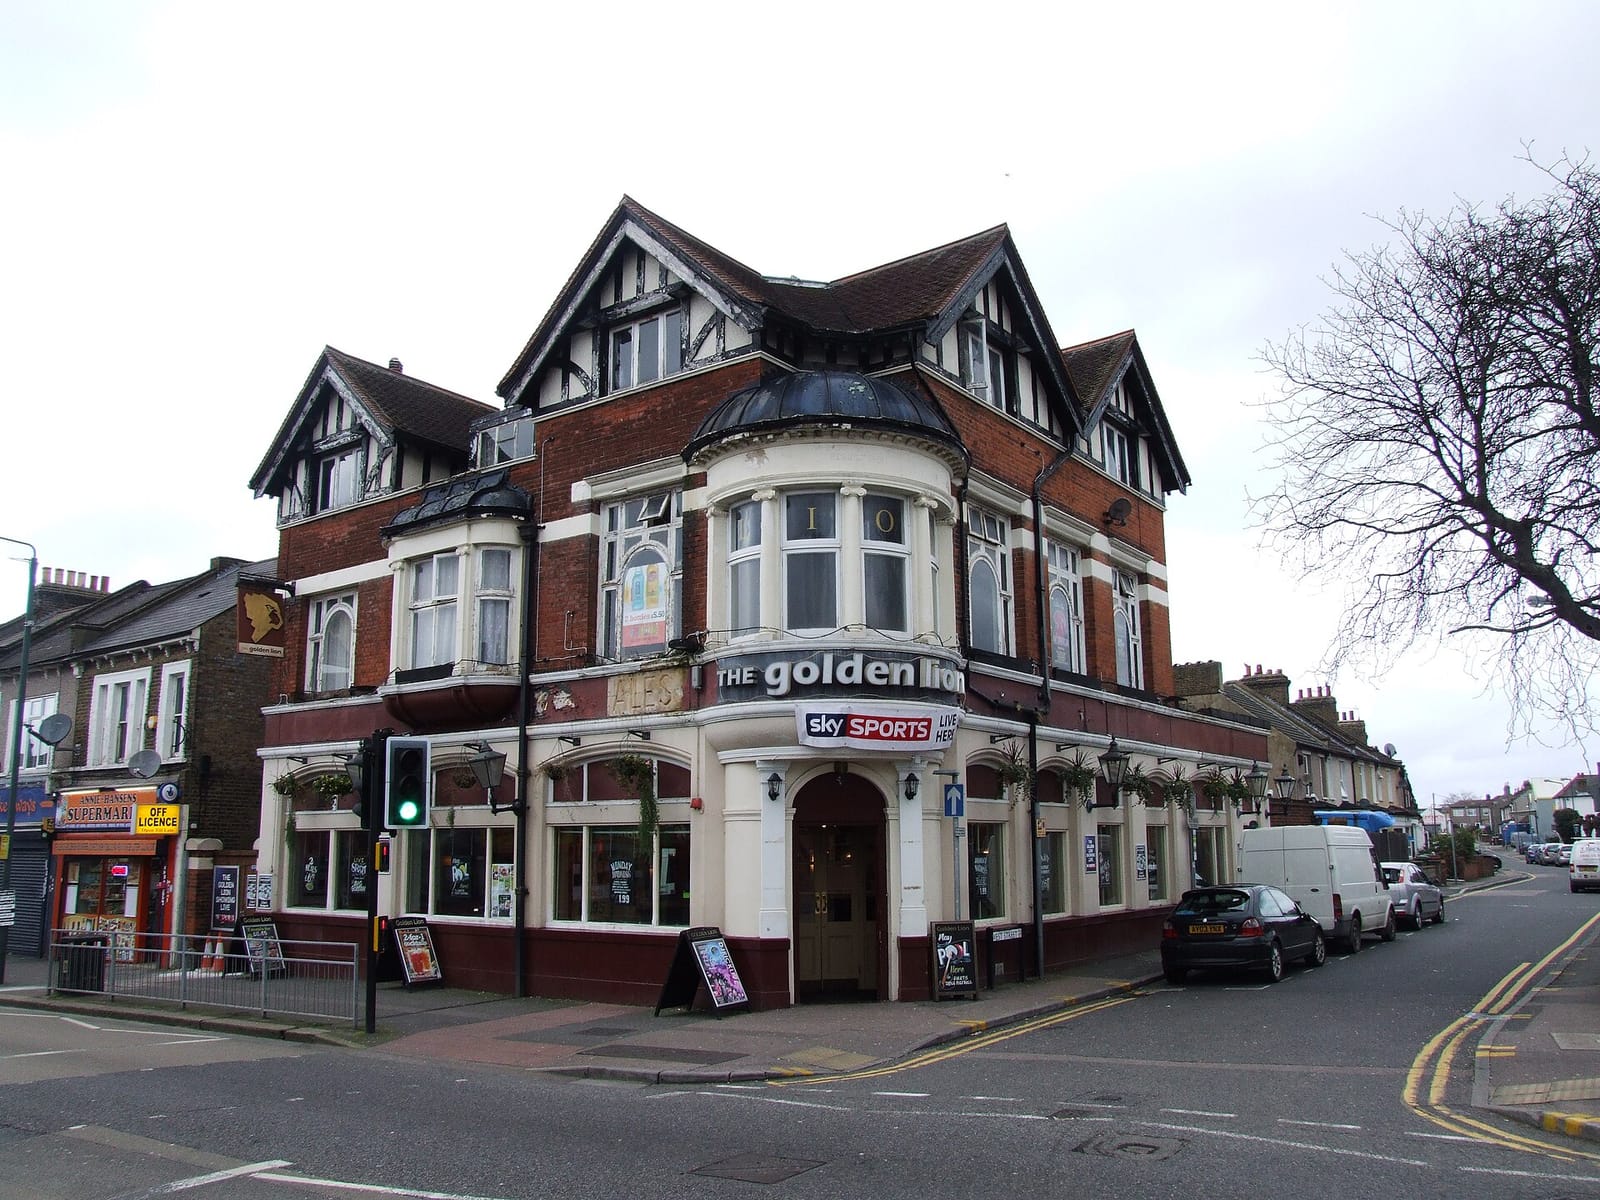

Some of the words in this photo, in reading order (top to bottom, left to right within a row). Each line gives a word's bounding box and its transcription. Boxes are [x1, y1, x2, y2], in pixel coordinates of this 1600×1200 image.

[716, 667, 756, 687] THE
[764, 653, 915, 696] golden
[919, 657, 966, 694] lion
[613, 674, 673, 711] ALES
[810, 714, 844, 736] sky
[849, 717, 929, 740] SPORTS
[939, 713, 957, 728] LIVE
[138, 817, 177, 827] LICENCE
[149, 807, 168, 817] OFF
[938, 933, 952, 944] Play
[937, 941, 970, 966] POOL
